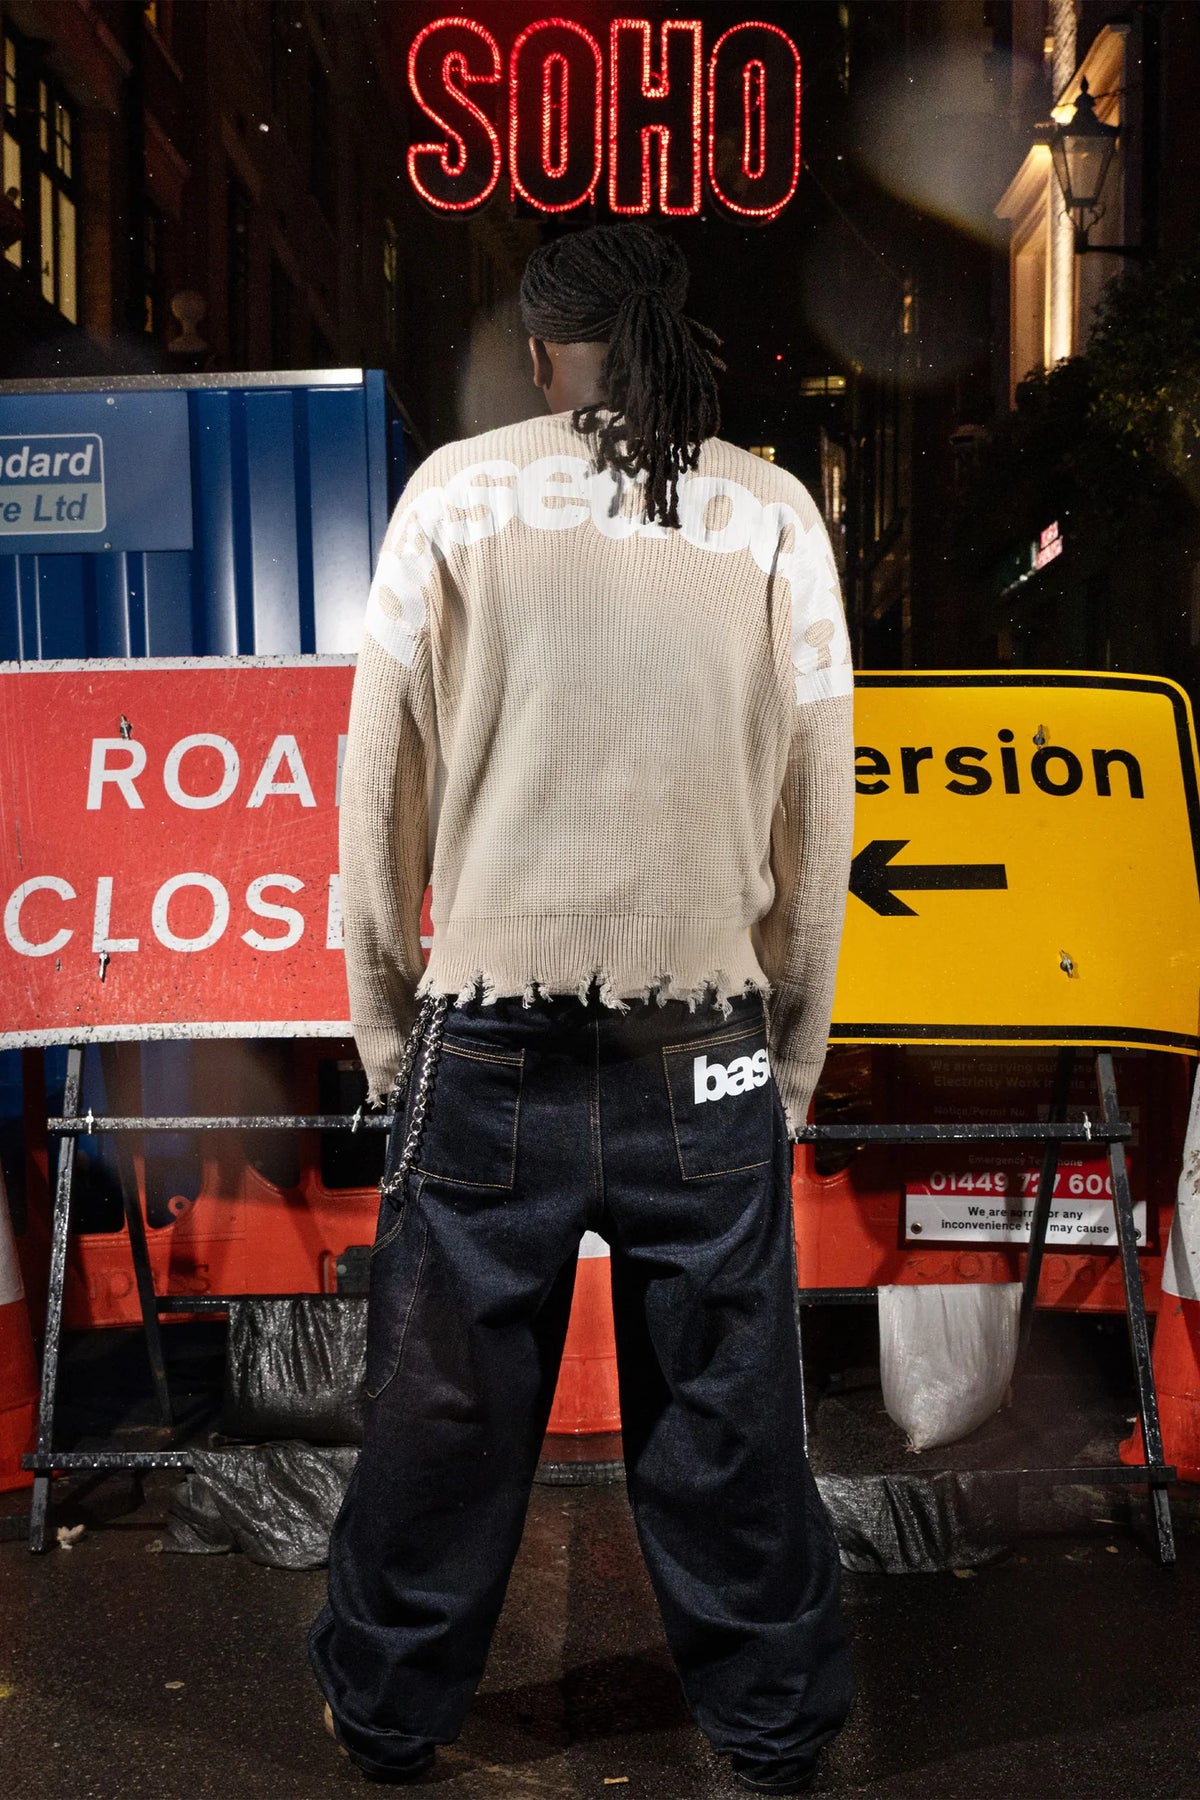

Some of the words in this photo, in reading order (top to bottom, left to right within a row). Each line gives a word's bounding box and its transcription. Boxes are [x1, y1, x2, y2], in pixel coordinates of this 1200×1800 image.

[407, 16, 802, 220] SOHO
[0, 444, 94, 479] dard
[33, 493, 89, 523] Ltd
[86, 733, 346, 811] ROA
[3, 872, 346, 958] CLOS
[693, 1047, 772, 1105] bas
[930, 1171, 1009, 1193] 01449
[941, 1220, 1022, 1231] inconvenience
[1050, 1224, 1073, 1234] may
[1076, 1224, 1110, 1234] cause
[968, 1206, 985, 1216] We
[988, 1209, 1007, 1217] are
[1010, 1209, 1034, 1218] sorr
[1063, 1210, 1083, 1220] any
